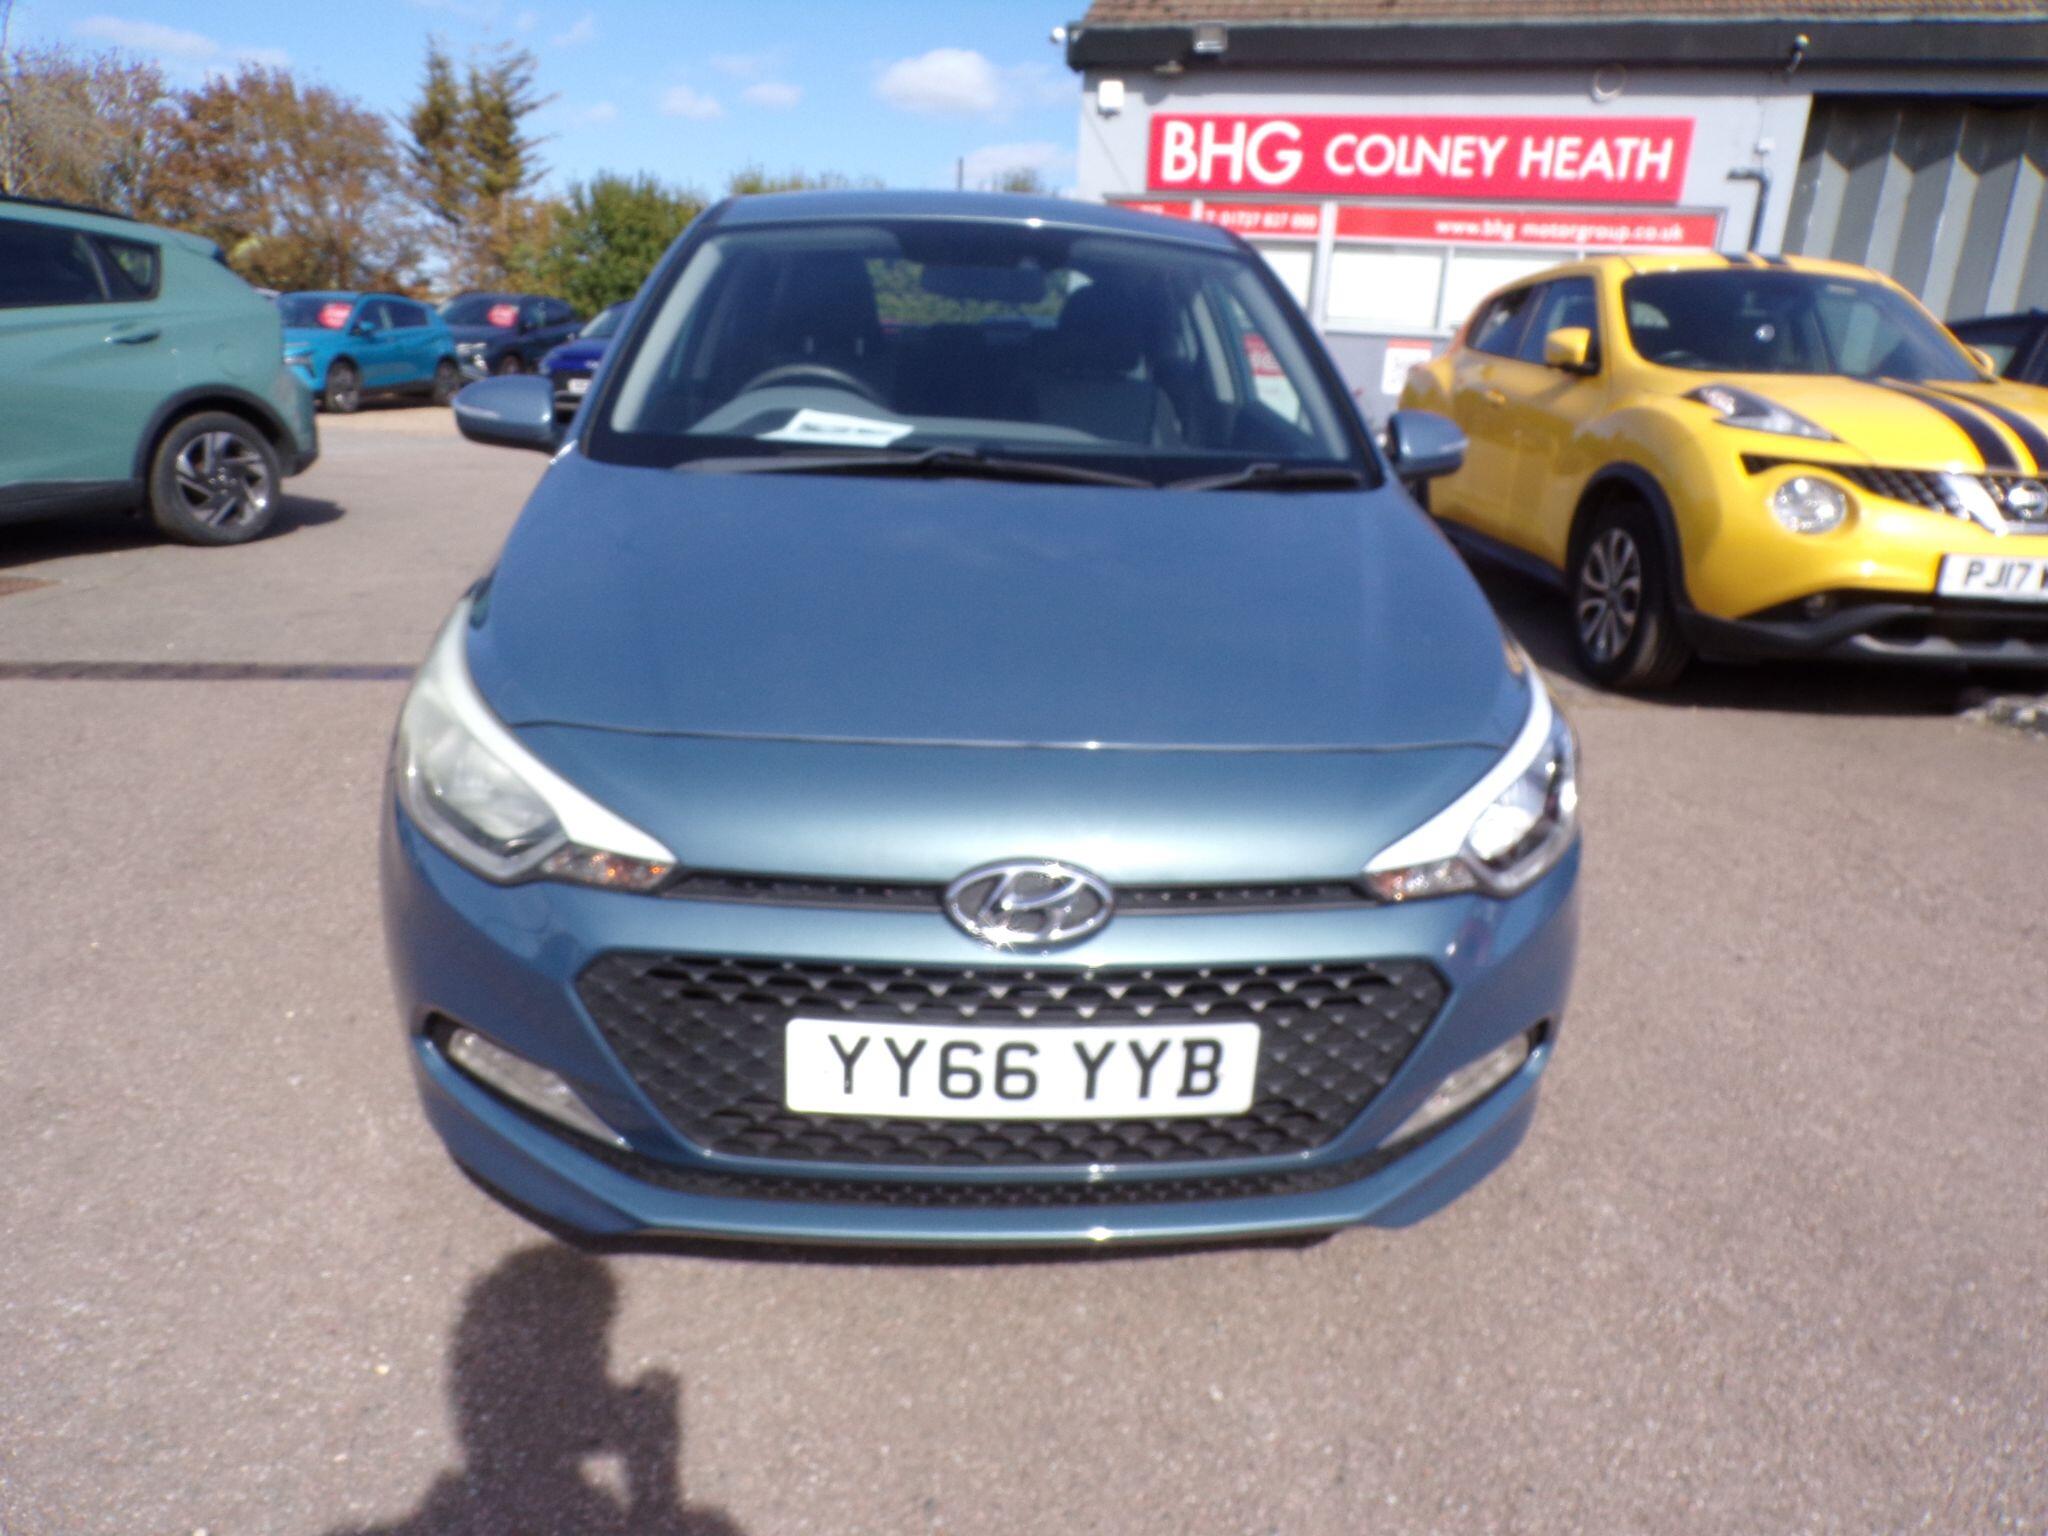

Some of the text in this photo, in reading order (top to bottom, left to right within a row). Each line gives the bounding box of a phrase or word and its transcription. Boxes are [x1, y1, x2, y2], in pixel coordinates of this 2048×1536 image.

[1161, 120, 1674, 185] BHG COLNEY HEATH
[1964, 560, 2033, 590] PJ17
[828, 1034, 1224, 1100] YY66 YYB
